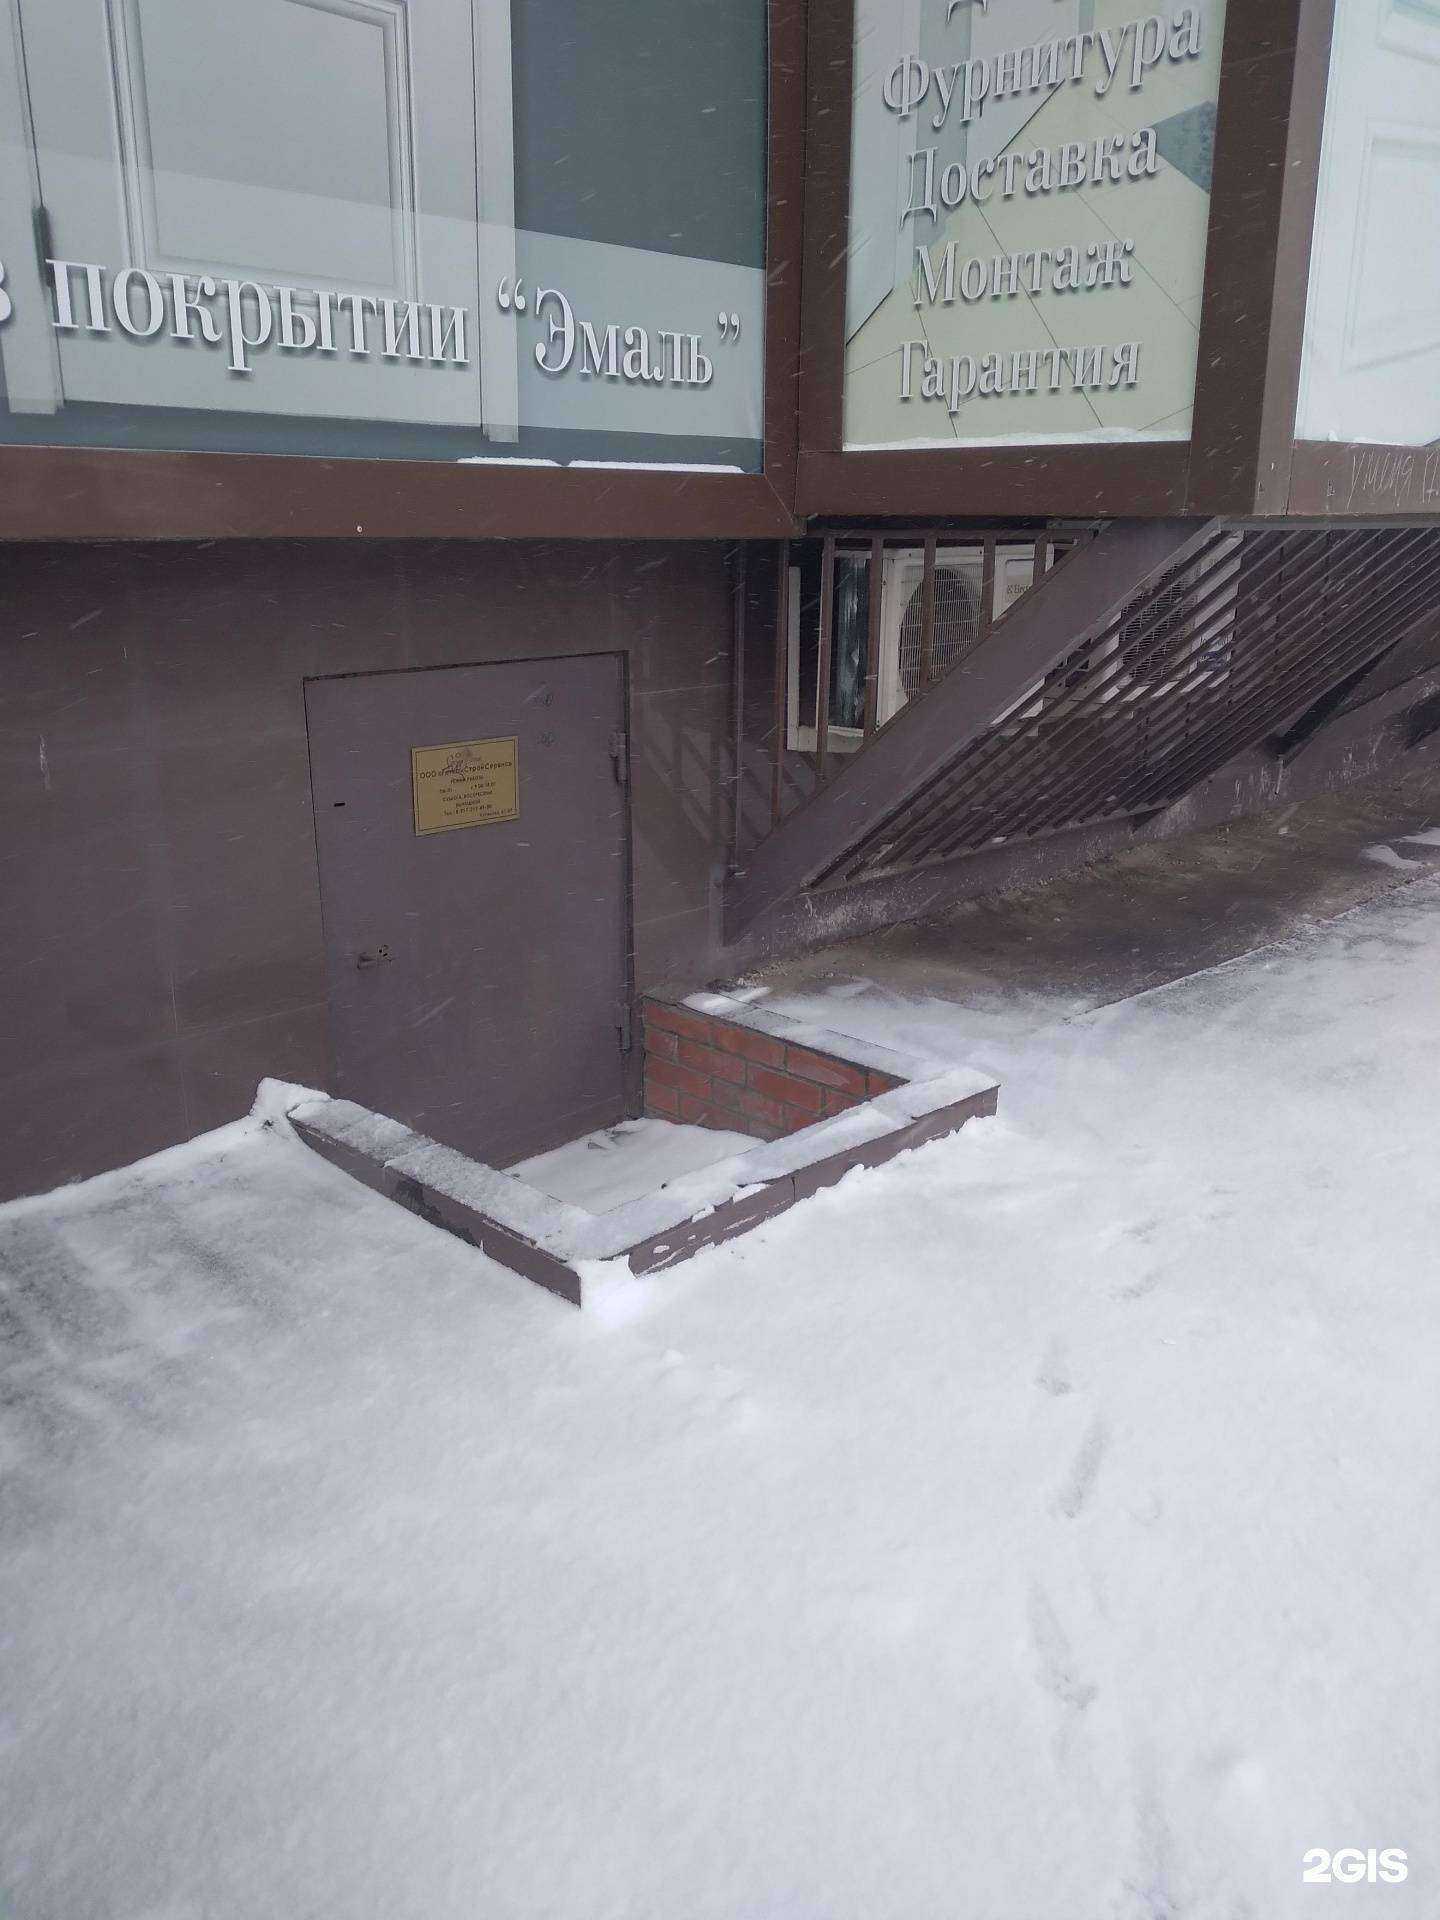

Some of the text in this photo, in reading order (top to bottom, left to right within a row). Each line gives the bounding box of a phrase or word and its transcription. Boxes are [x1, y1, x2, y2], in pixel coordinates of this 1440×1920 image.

[883, 8, 1201, 128] Фурнитура
[901, 126, 1159, 227] Доставка
[45, 258, 470, 372] покрытии
[914, 238, 1135, 306] Монтаж
[899, 339, 1144, 414] Гарантия
